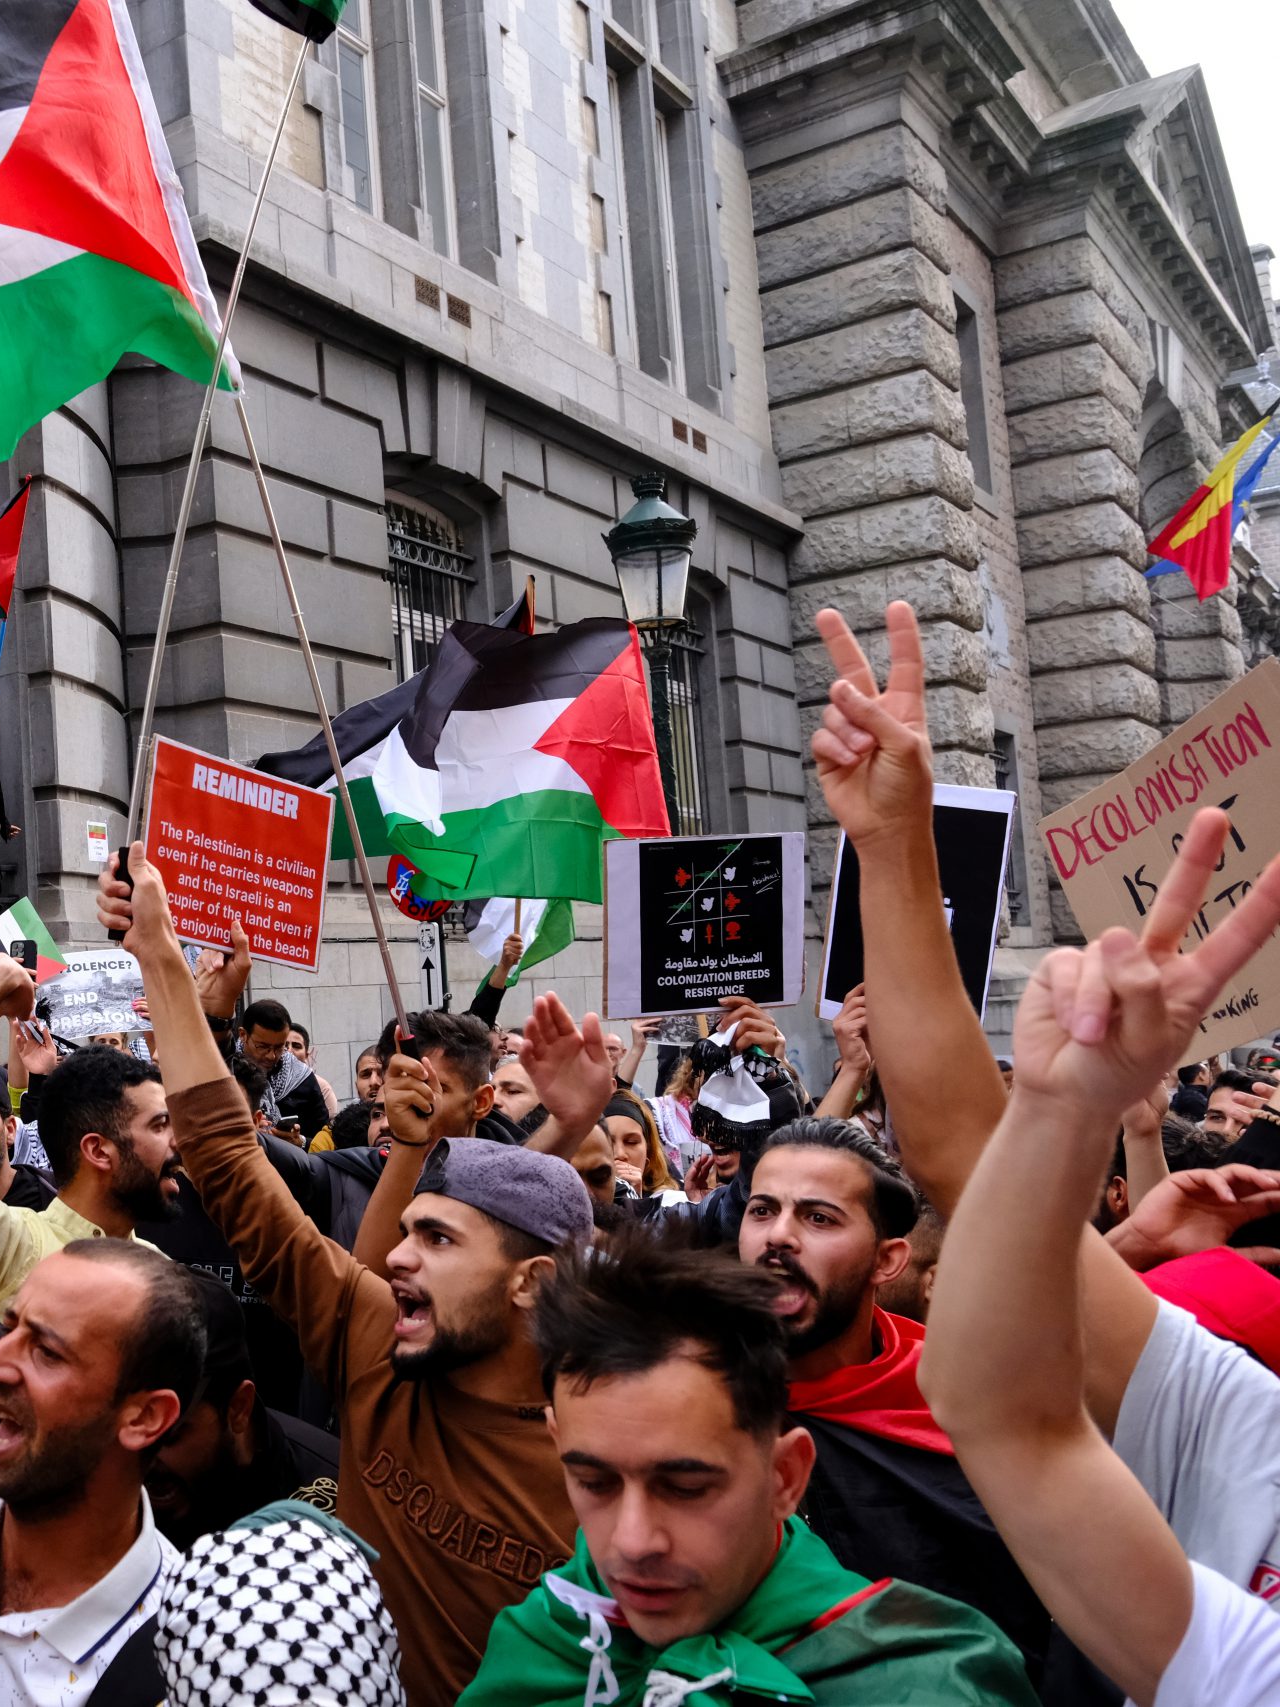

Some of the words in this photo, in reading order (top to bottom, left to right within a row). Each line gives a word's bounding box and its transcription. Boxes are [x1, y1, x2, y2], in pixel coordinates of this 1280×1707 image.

[192, 763, 299, 820] REMINDER
[160, 821, 183, 841] The
[186, 829, 251, 862] Palestinian
[254, 849, 264, 865] is
[266, 856, 273, 868] a
[276, 857, 317, 880] civilian
[158, 845, 187, 864] even
[189, 851, 199, 867] if
[201, 855, 217, 872] he
[219, 863, 260, 884] carries
[263, 875, 314, 902] weapons
[178, 872, 200, 890] and
[203, 877, 223, 895] the
[225, 884, 262, 906] Israeli
[264, 894, 274, 909] is
[277, 901, 292, 914] an
[1122, 864, 1158, 916] IS
[167, 891, 205, 912] cupier
[207, 902, 220, 916] of
[223, 905, 242, 922] the
[245, 910, 270, 929] land
[273, 920, 301, 937] even
[304, 924, 313, 940] if
[181, 918, 231, 944] enjoying
[253, 933, 272, 950] the
[275, 937, 310, 960] beach
[66, 961, 132, 974] IOLENCE?
[657, 972, 732, 986] COLONIZATION
[734, 969, 771, 980] BREEDS
[63, 992, 98, 1007] END
[685, 985, 745, 998] RESISTANCE
